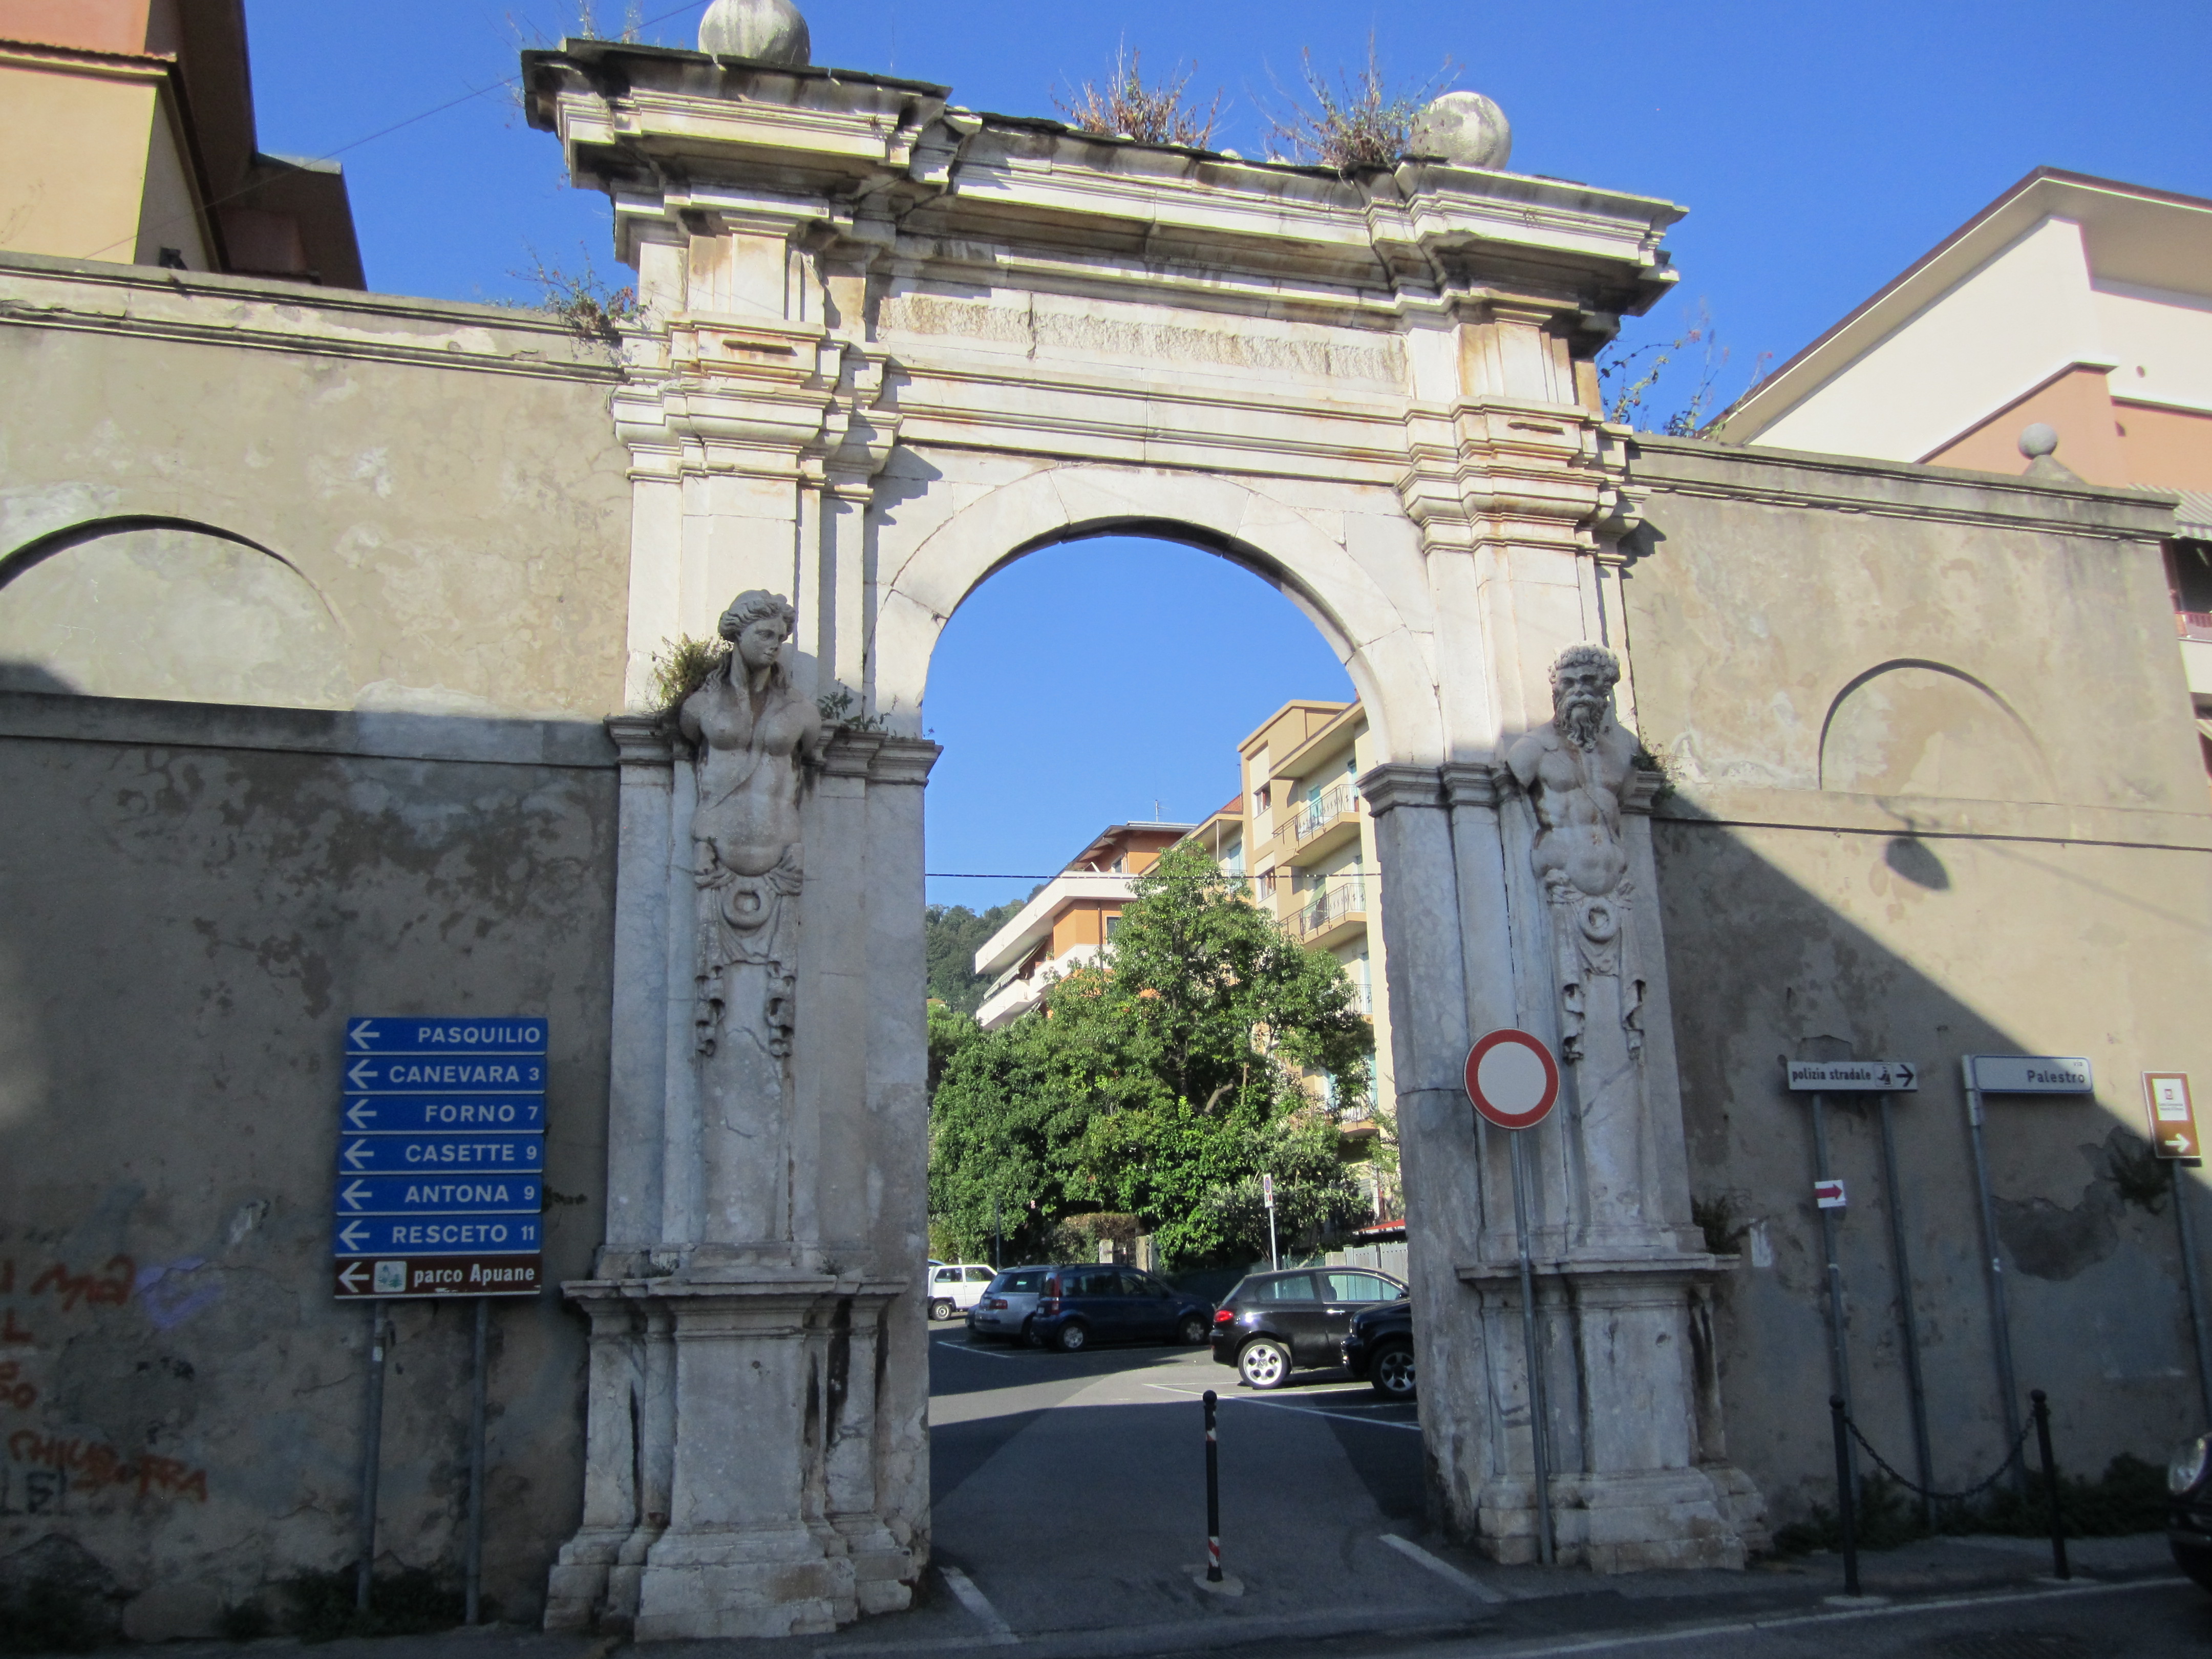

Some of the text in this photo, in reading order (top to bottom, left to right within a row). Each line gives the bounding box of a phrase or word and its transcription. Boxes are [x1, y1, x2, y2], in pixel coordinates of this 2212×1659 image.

[418, 1027, 540, 1044] PASQUILIO
[389, 1066, 539, 1082] CANEVARA 3
[1792, 1068, 1871, 1081] polizia stradale
[2027, 1069, 2085, 1083] Palestro
[425, 1104, 538, 1122] FORNO 7
[405, 1144, 537, 1162] CASETTE 9
[405, 1185, 535, 1203] ANTONA 9
[392, 1224, 534, 1243] RESCETO 11
[413, 1263, 535, 1287] parco Apuane
